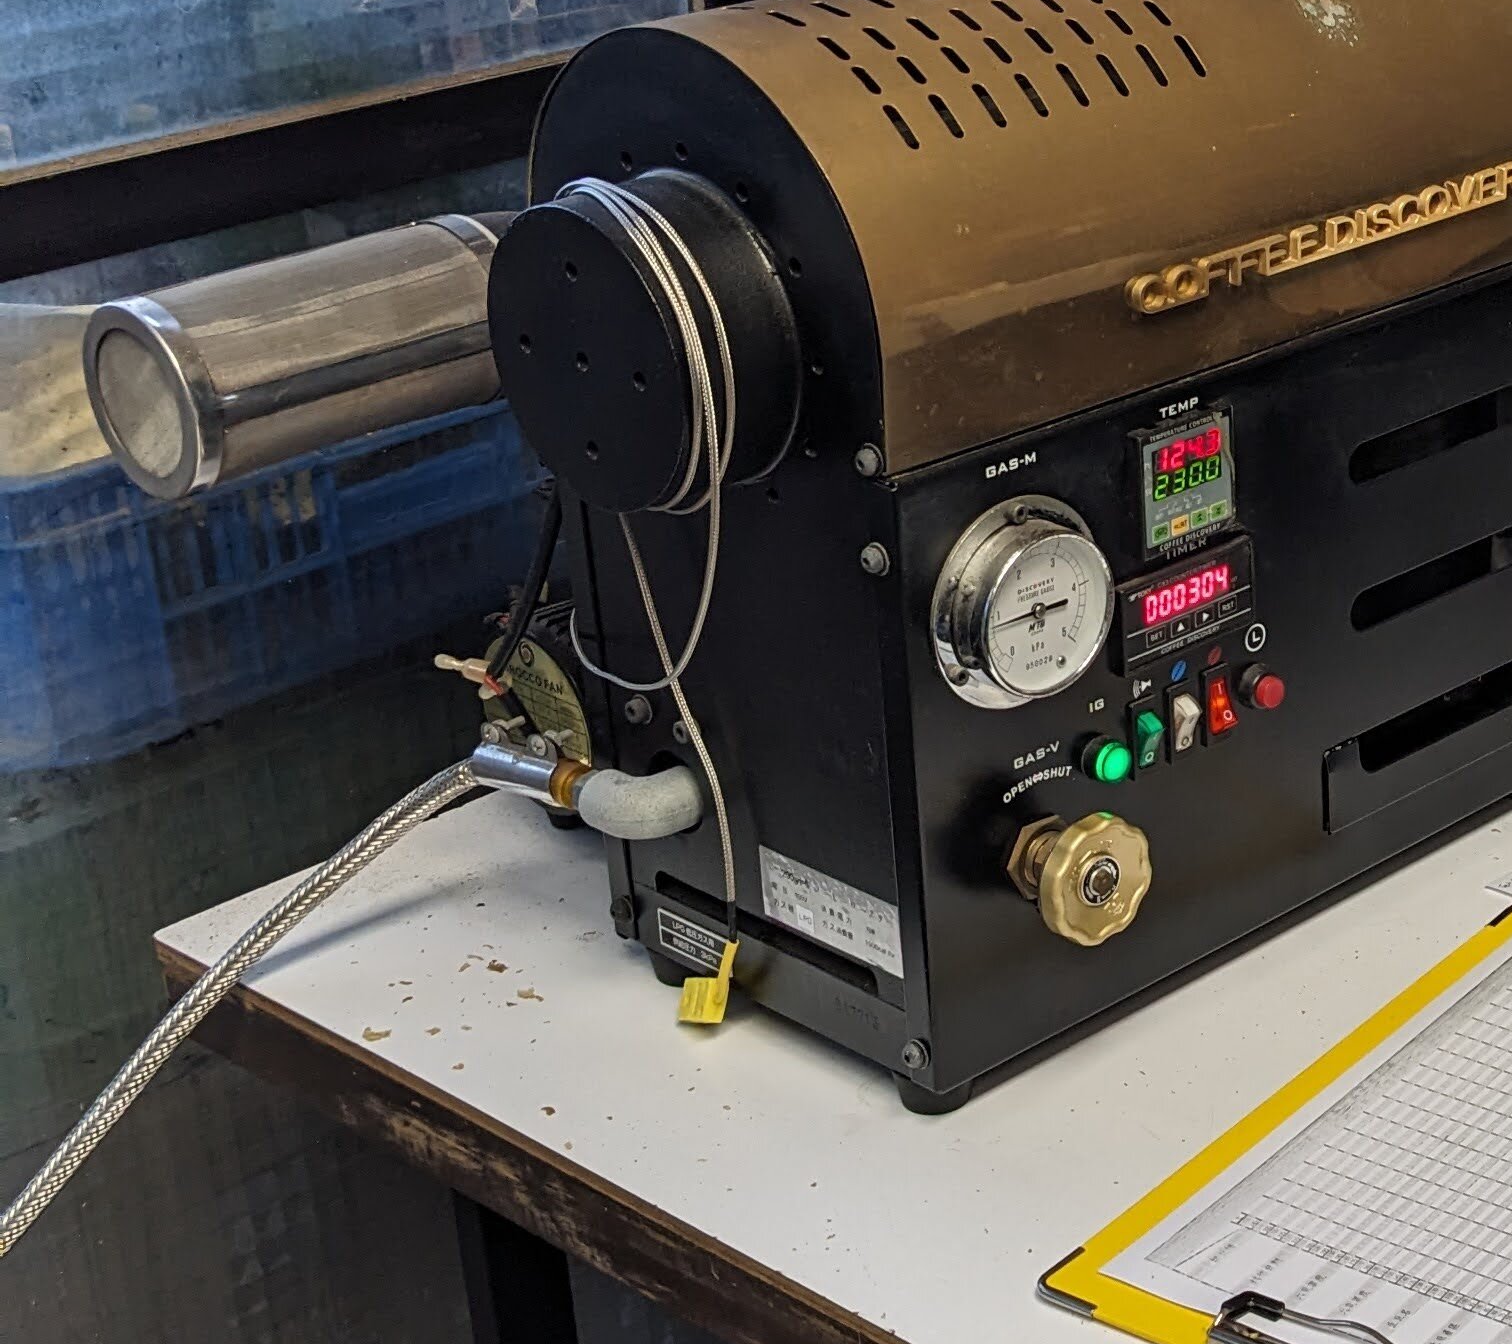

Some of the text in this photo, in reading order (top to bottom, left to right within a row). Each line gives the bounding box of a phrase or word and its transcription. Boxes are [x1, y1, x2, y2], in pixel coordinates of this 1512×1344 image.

[1124, 224, 1319, 314] COFFEE
[1159, 396, 1199, 419] TEMP
[985, 451, 1037, 479] GAS-M
[1166, 537, 1207, 560] TIMER
[1145, 564, 1229, 625] 000304
[1088, 697, 1105, 714] IG
[1014, 740, 1060, 770] GAS-V
